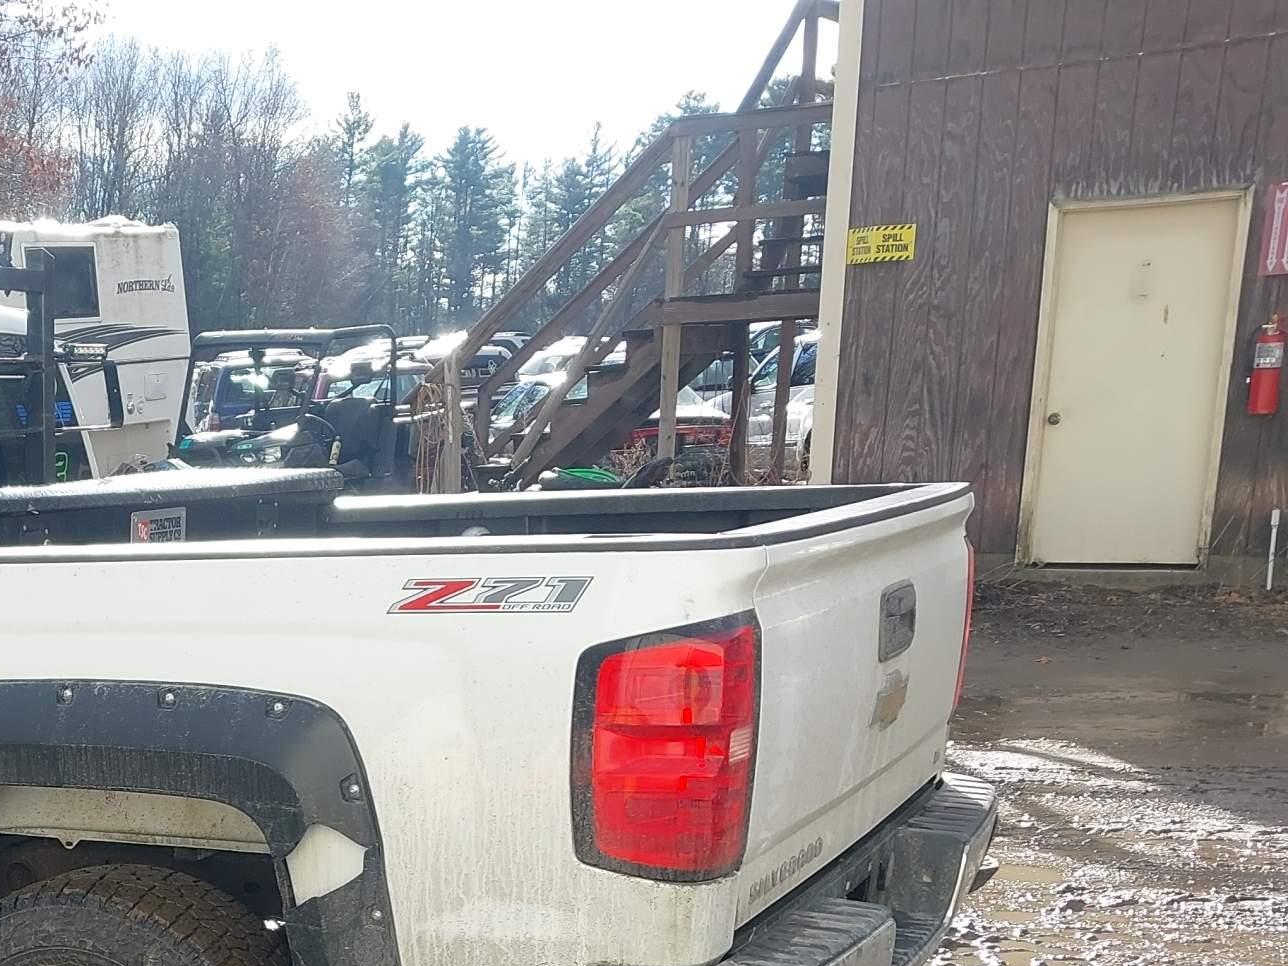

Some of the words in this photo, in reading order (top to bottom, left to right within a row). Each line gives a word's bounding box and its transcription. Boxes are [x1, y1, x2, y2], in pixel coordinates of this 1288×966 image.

[882, 233, 904, 243] SPILL
[875, 243, 909, 253] STATION
[116, 279, 160, 295] NORTHERN
[150, 516, 182, 532] TRACTOR
[387, 576, 595, 615] Z71
[502, 603, 529, 611] OFF
[531, 603, 572, 611] ROAD
